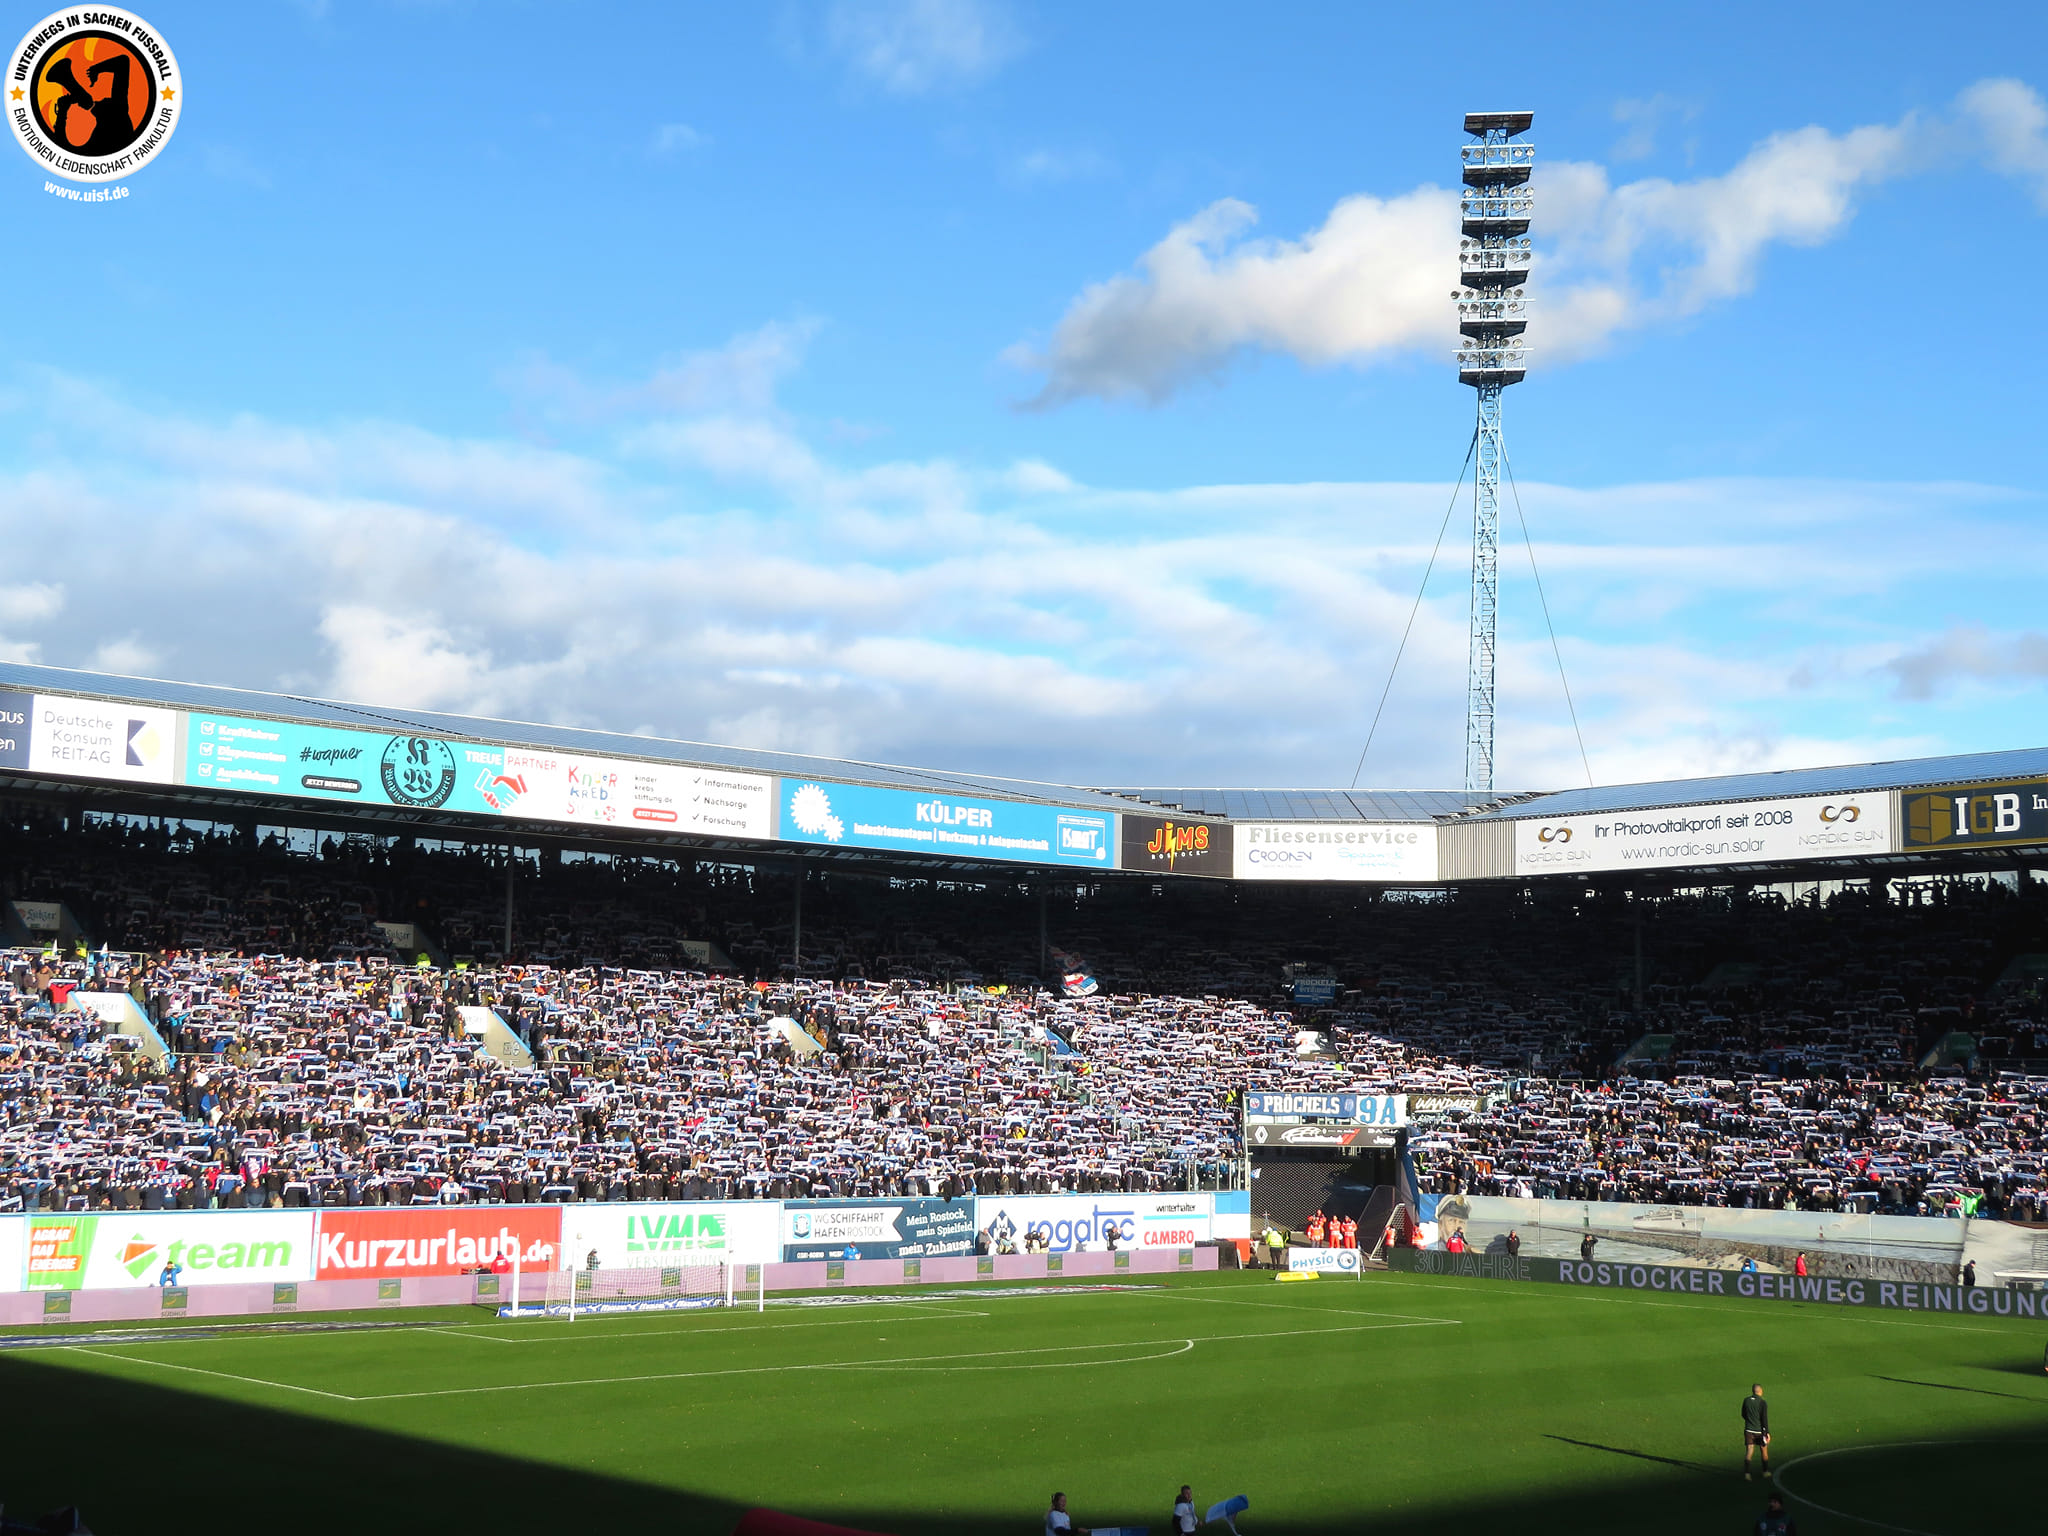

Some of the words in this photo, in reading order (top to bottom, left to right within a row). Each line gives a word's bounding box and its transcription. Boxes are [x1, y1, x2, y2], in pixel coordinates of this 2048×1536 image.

[44, 710, 113, 730] Deutsche
[53, 729, 112, 747] Konsum
[464, 750, 502, 766] TREUE
[507, 755, 557, 771] PARTNER
[704, 778, 763, 792] Informationen
[703, 797, 748, 810] Nachsorge
[703, 815, 746, 829] Forschung
[916, 800, 993, 828] KÜLPER
[1955, 793, 2020, 836] IGB
[1594, 824, 1610, 838] Ihr
[1614, 816, 1722, 836] Photovoltaikprofi
[1726, 813, 1749, 828] seit
[1754, 810, 1793, 826] 2008
[1248, 827, 1418, 844] Fliesenservice
[1799, 832, 1849, 845] NORDIC
[1854, 829, 1883, 842] SUN
[1520, 852, 1562, 864] NORDIC
[1567, 850, 1592, 861] SUN
[1621, 838, 1765, 859] www.nordic-sun.solar
[1264, 1093, 1340, 1114] PRÖCHELS
[1415, 1097, 1478, 1111] WANDALEN
[1373, 1136, 1396, 1146] Jeep
[1156, 1203, 1196, 1213] winterhalter
[830, 1212, 884, 1224] SCHIFFAHRT
[906, 1214, 928, 1226] Mein
[930, 1208, 967, 1223] Rostock,
[32, 1229, 71, 1241] AGRAR
[627, 1214, 694, 1251] LVM
[814, 1227, 846, 1238] HAFEN
[846, 1226, 884, 1238] ROSTOCK
[916, 1225, 936, 1237] mein
[1028, 1204, 1135, 1252] rogatec
[1144, 1230, 1195, 1246] CAMBRO
[32, 1244, 55, 1256] BAU
[168, 1237, 293, 1270] team
[320, 1227, 554, 1270] Kurzurlaub.de
[899, 1243, 924, 1256] mein
[925, 1238, 973, 1256] Zuhause.
[31, 1258, 77, 1271] ENERGIE
[1293, 1251, 1333, 1269] PHYSIO
[1415, 1249, 1443, 1273] 30
[1448, 1252, 1531, 1280] JAHRE
[1559, 1261, 1724, 1294] ROSTOCKER
[1738, 1274, 1865, 1304] GEHWEG
